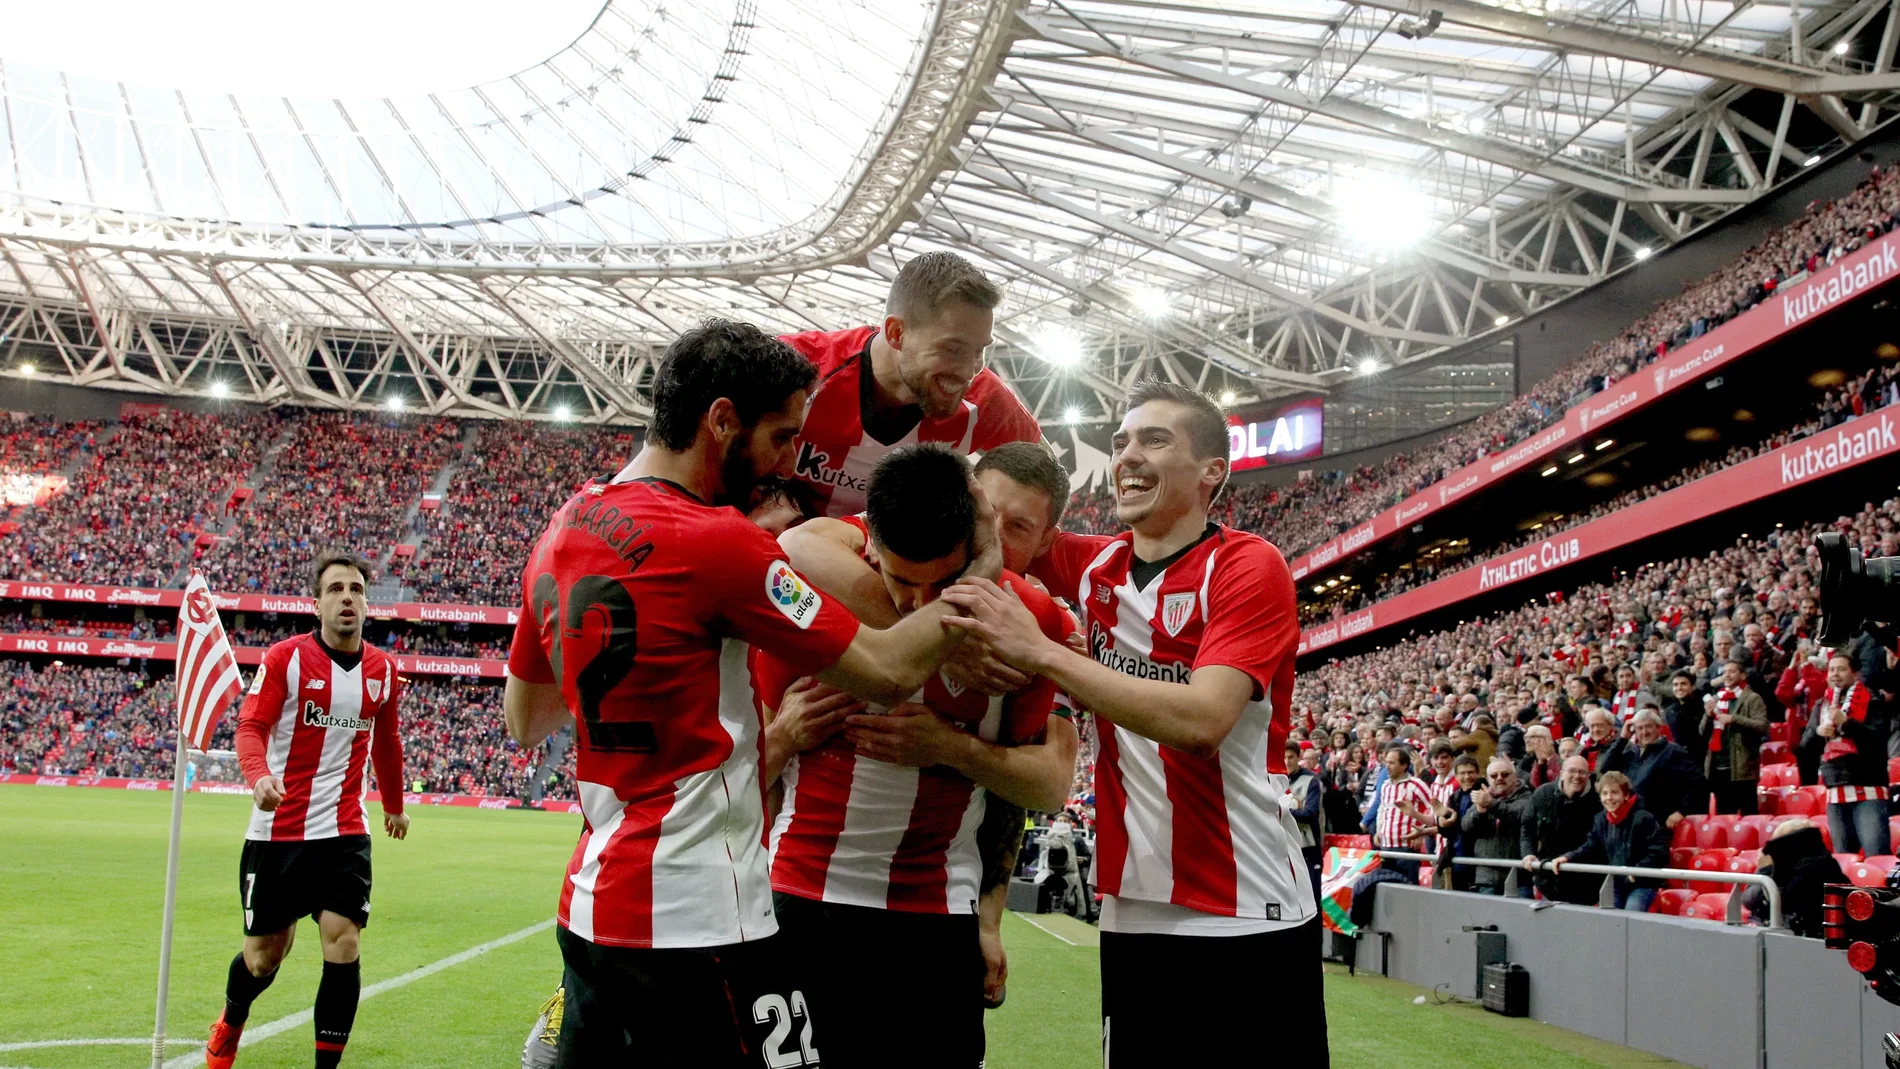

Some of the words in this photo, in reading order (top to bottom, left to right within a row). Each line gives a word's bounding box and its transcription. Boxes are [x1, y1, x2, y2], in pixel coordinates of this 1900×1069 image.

[1783, 240, 1898, 327] kutxabank
[1781, 414, 1896, 484] kutxabank
[566, 496, 656, 574] GARCÍA
[1480, 554, 1537, 590] ATHLETIC
[1541, 538, 1579, 568] CLUB
[21, 585, 54, 599] IMQ
[64, 588, 96, 602] IMQ
[262, 598, 312, 612] kutxaba
[420, 607, 486, 622] kutxabank
[16, 639, 49, 652] IMQ
[57, 641, 89, 654] IMQ
[415, 659, 482, 675] kutxabank
[245, 873, 256, 909] 7
[752, 990, 820, 1069] 22
